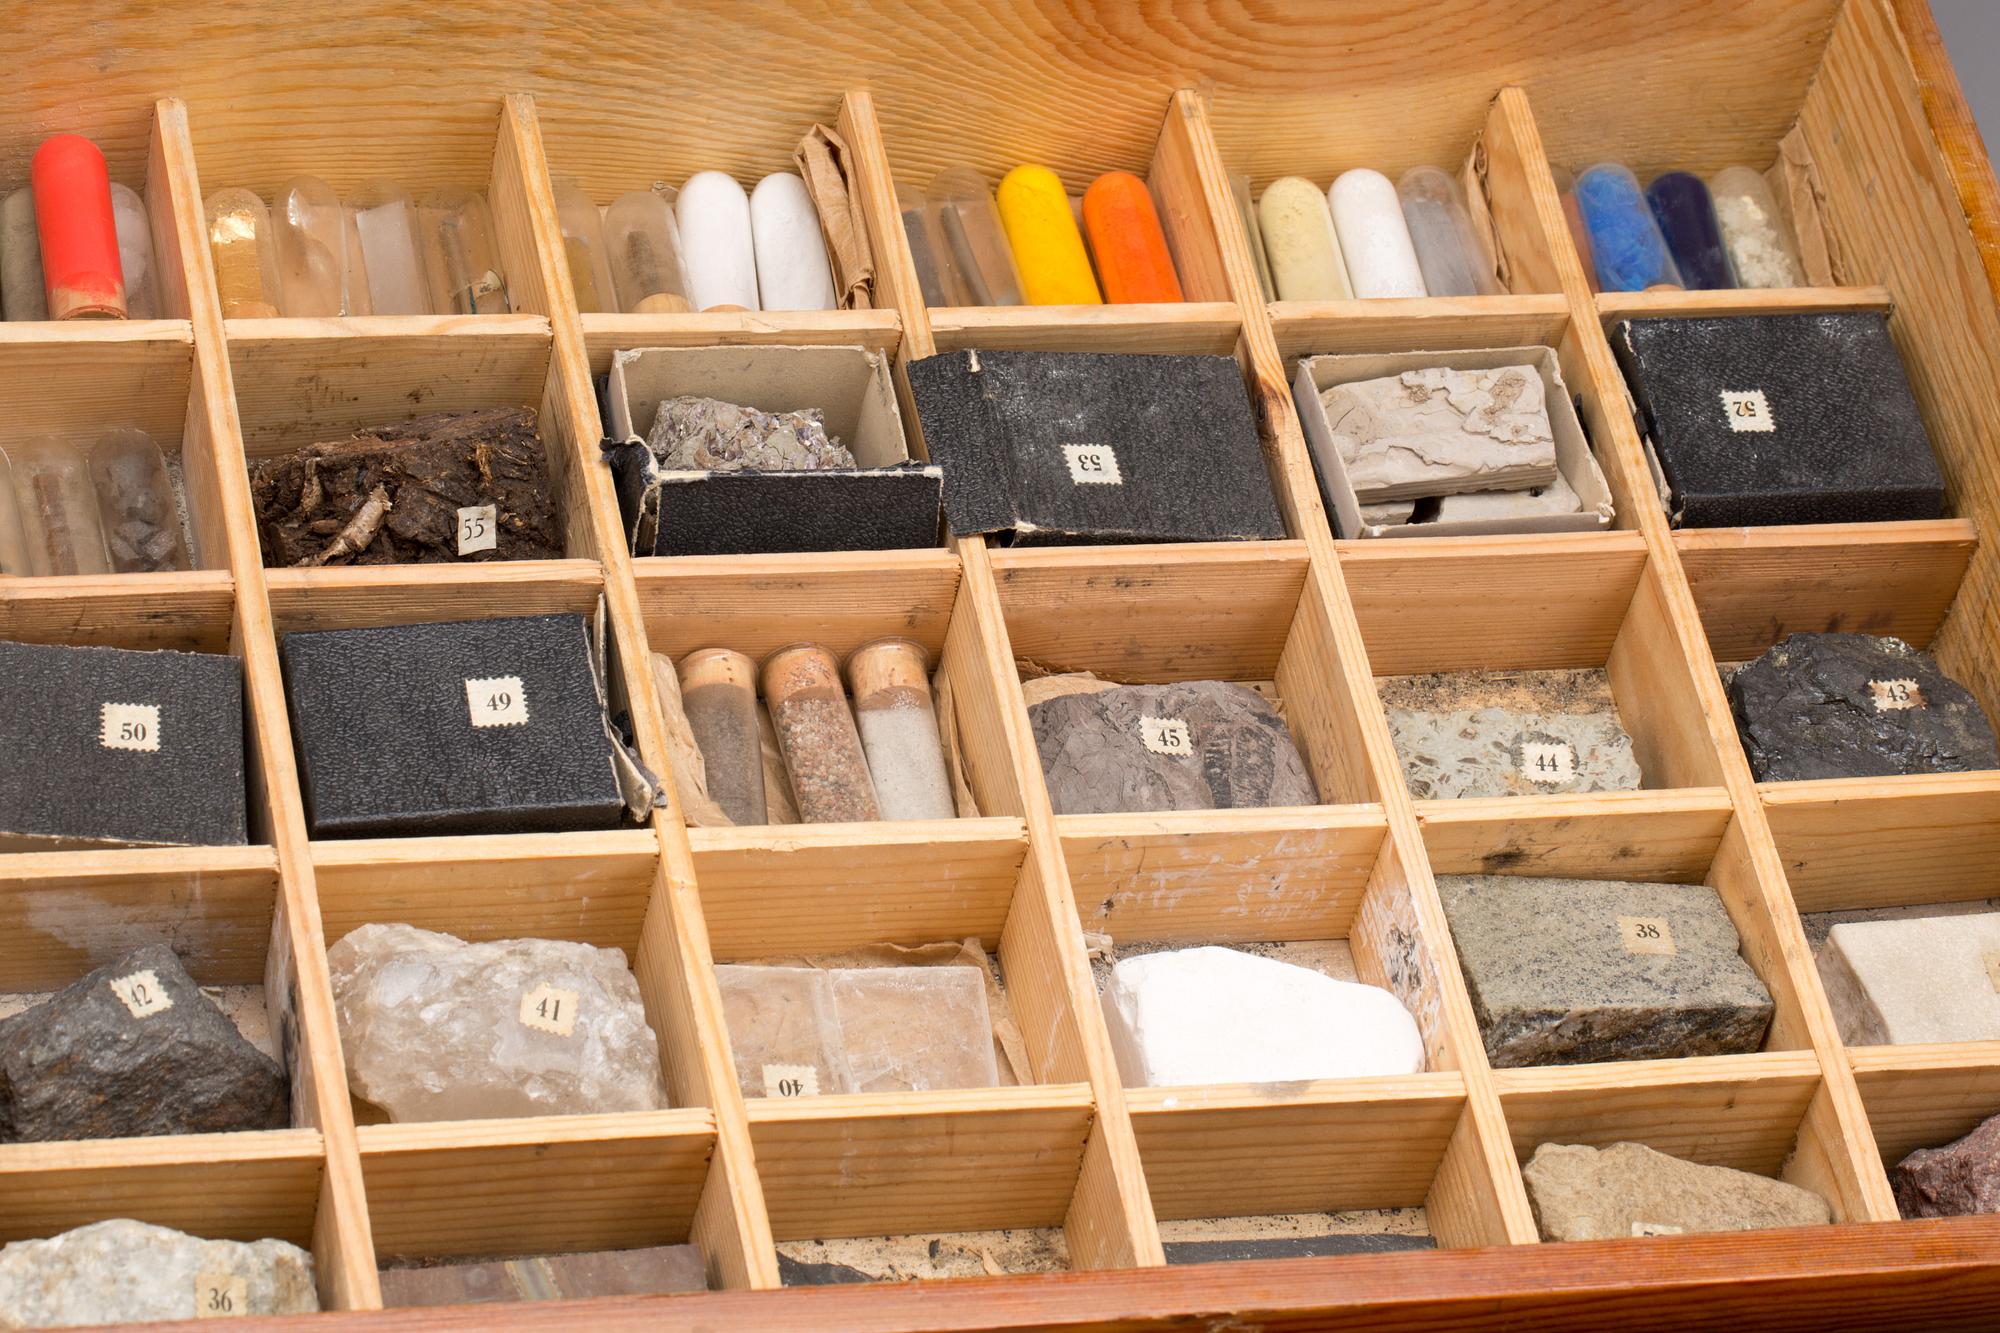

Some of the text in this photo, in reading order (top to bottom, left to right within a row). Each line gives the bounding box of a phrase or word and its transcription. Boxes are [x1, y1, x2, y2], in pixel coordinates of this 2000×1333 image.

[1732, 400, 1757, 418] 52
[1078, 453, 1102, 472] 53
[463, 517, 485, 541] 55
[486, 691, 512, 711] 49
[1886, 683, 1910, 703] 43
[120, 721, 147, 742] 50
[1157, 727, 1181, 748] 45
[1535, 753, 1558, 773] 44
[1635, 923, 1661, 939] 38
[130, 983, 153, 1008] 42
[535, 996, 561, 1022] 41
[778, 1078, 804, 1097] 40
[208, 1287, 233, 1313] 36
